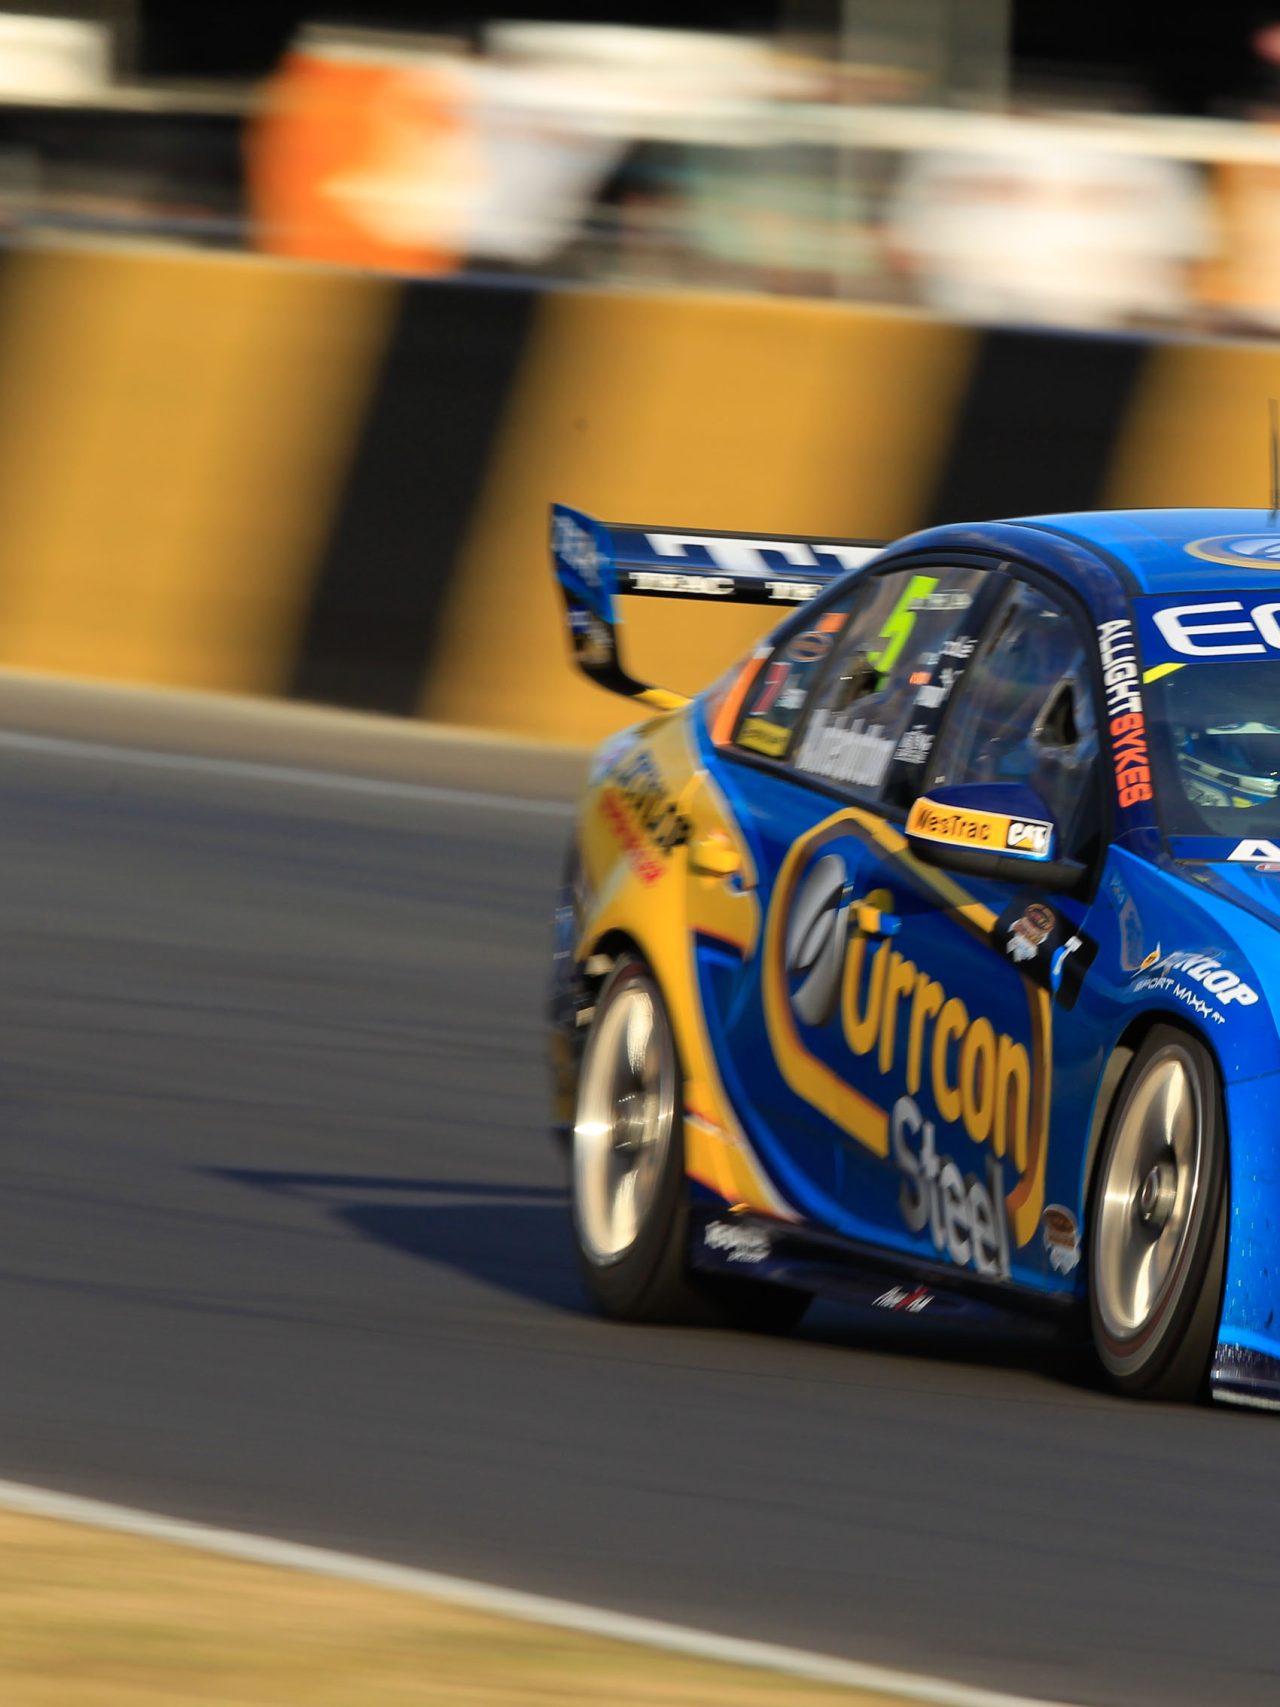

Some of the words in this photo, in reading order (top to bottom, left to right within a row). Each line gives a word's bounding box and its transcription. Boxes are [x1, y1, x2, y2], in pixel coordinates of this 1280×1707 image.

[917, 808, 990, 841] WesTrac
[1007, 823, 1047, 849] CAT
[1133, 977, 1174, 992] SPORT
[1173, 983, 1213, 1018] MAXX
[892, 1096, 1013, 1280] Steel
